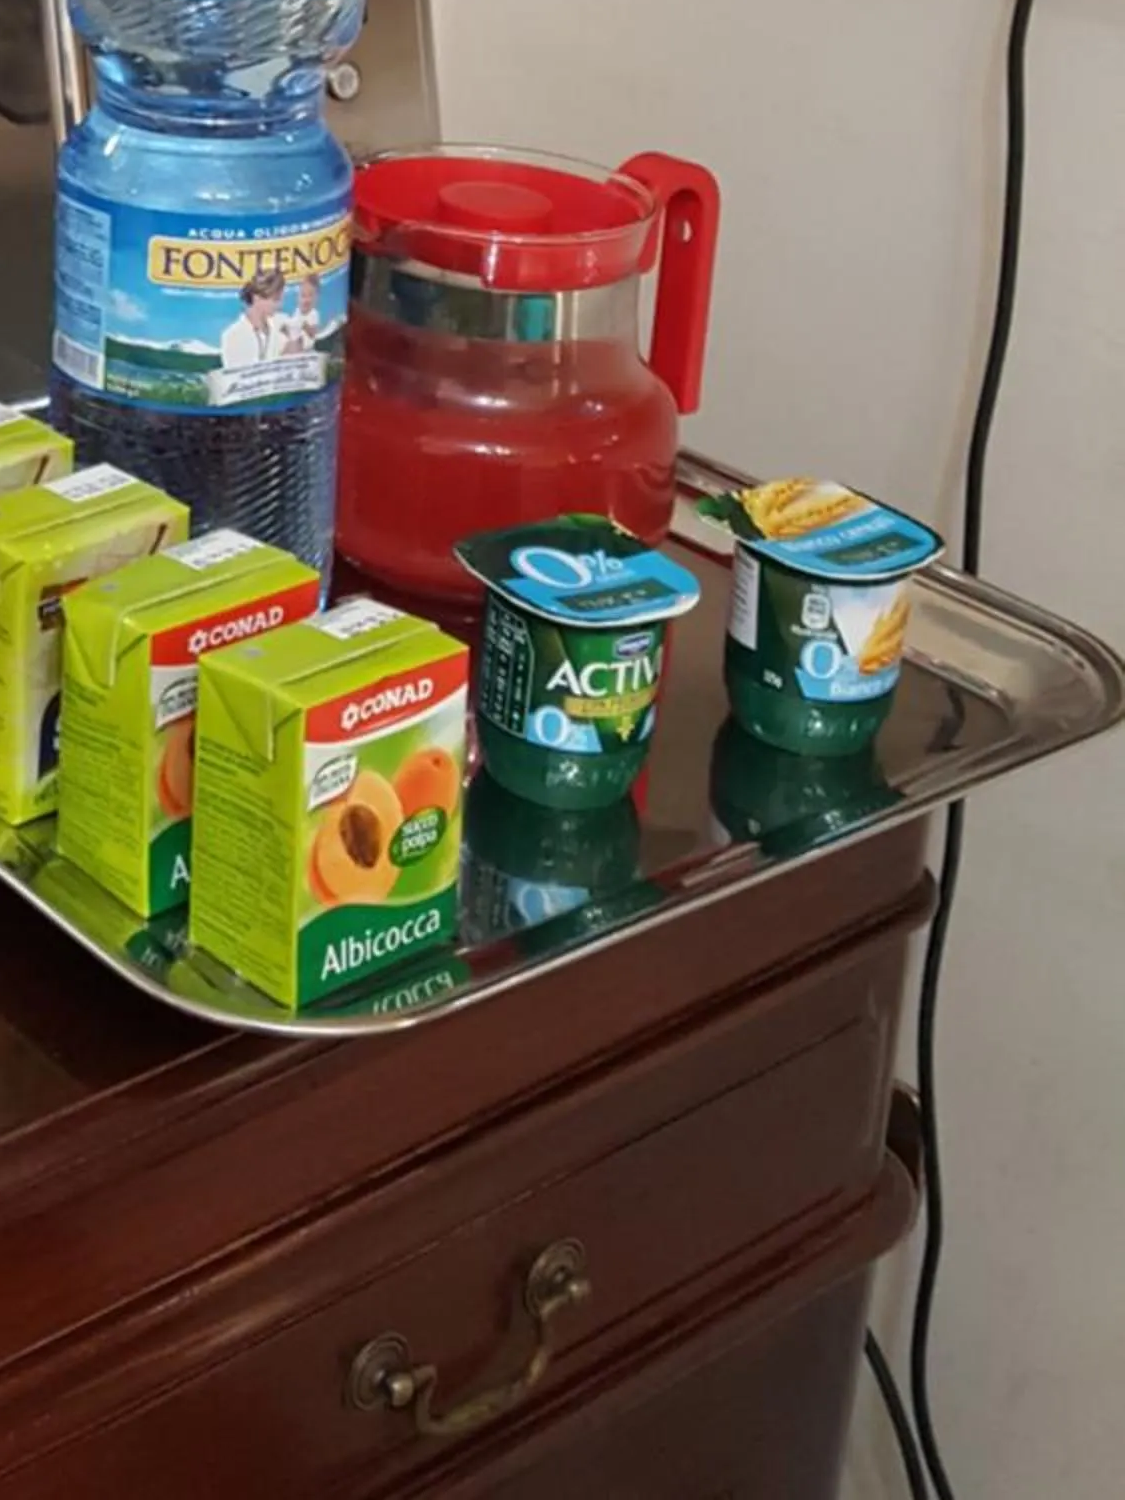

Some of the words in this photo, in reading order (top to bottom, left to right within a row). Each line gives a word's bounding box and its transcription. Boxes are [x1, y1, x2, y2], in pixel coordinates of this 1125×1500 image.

[188, 227, 246, 240] ACQUA
[209, 604, 284, 646] CONAD
[360, 677, 433, 721] CONAD
[320, 908, 441, 981] Albicocca
